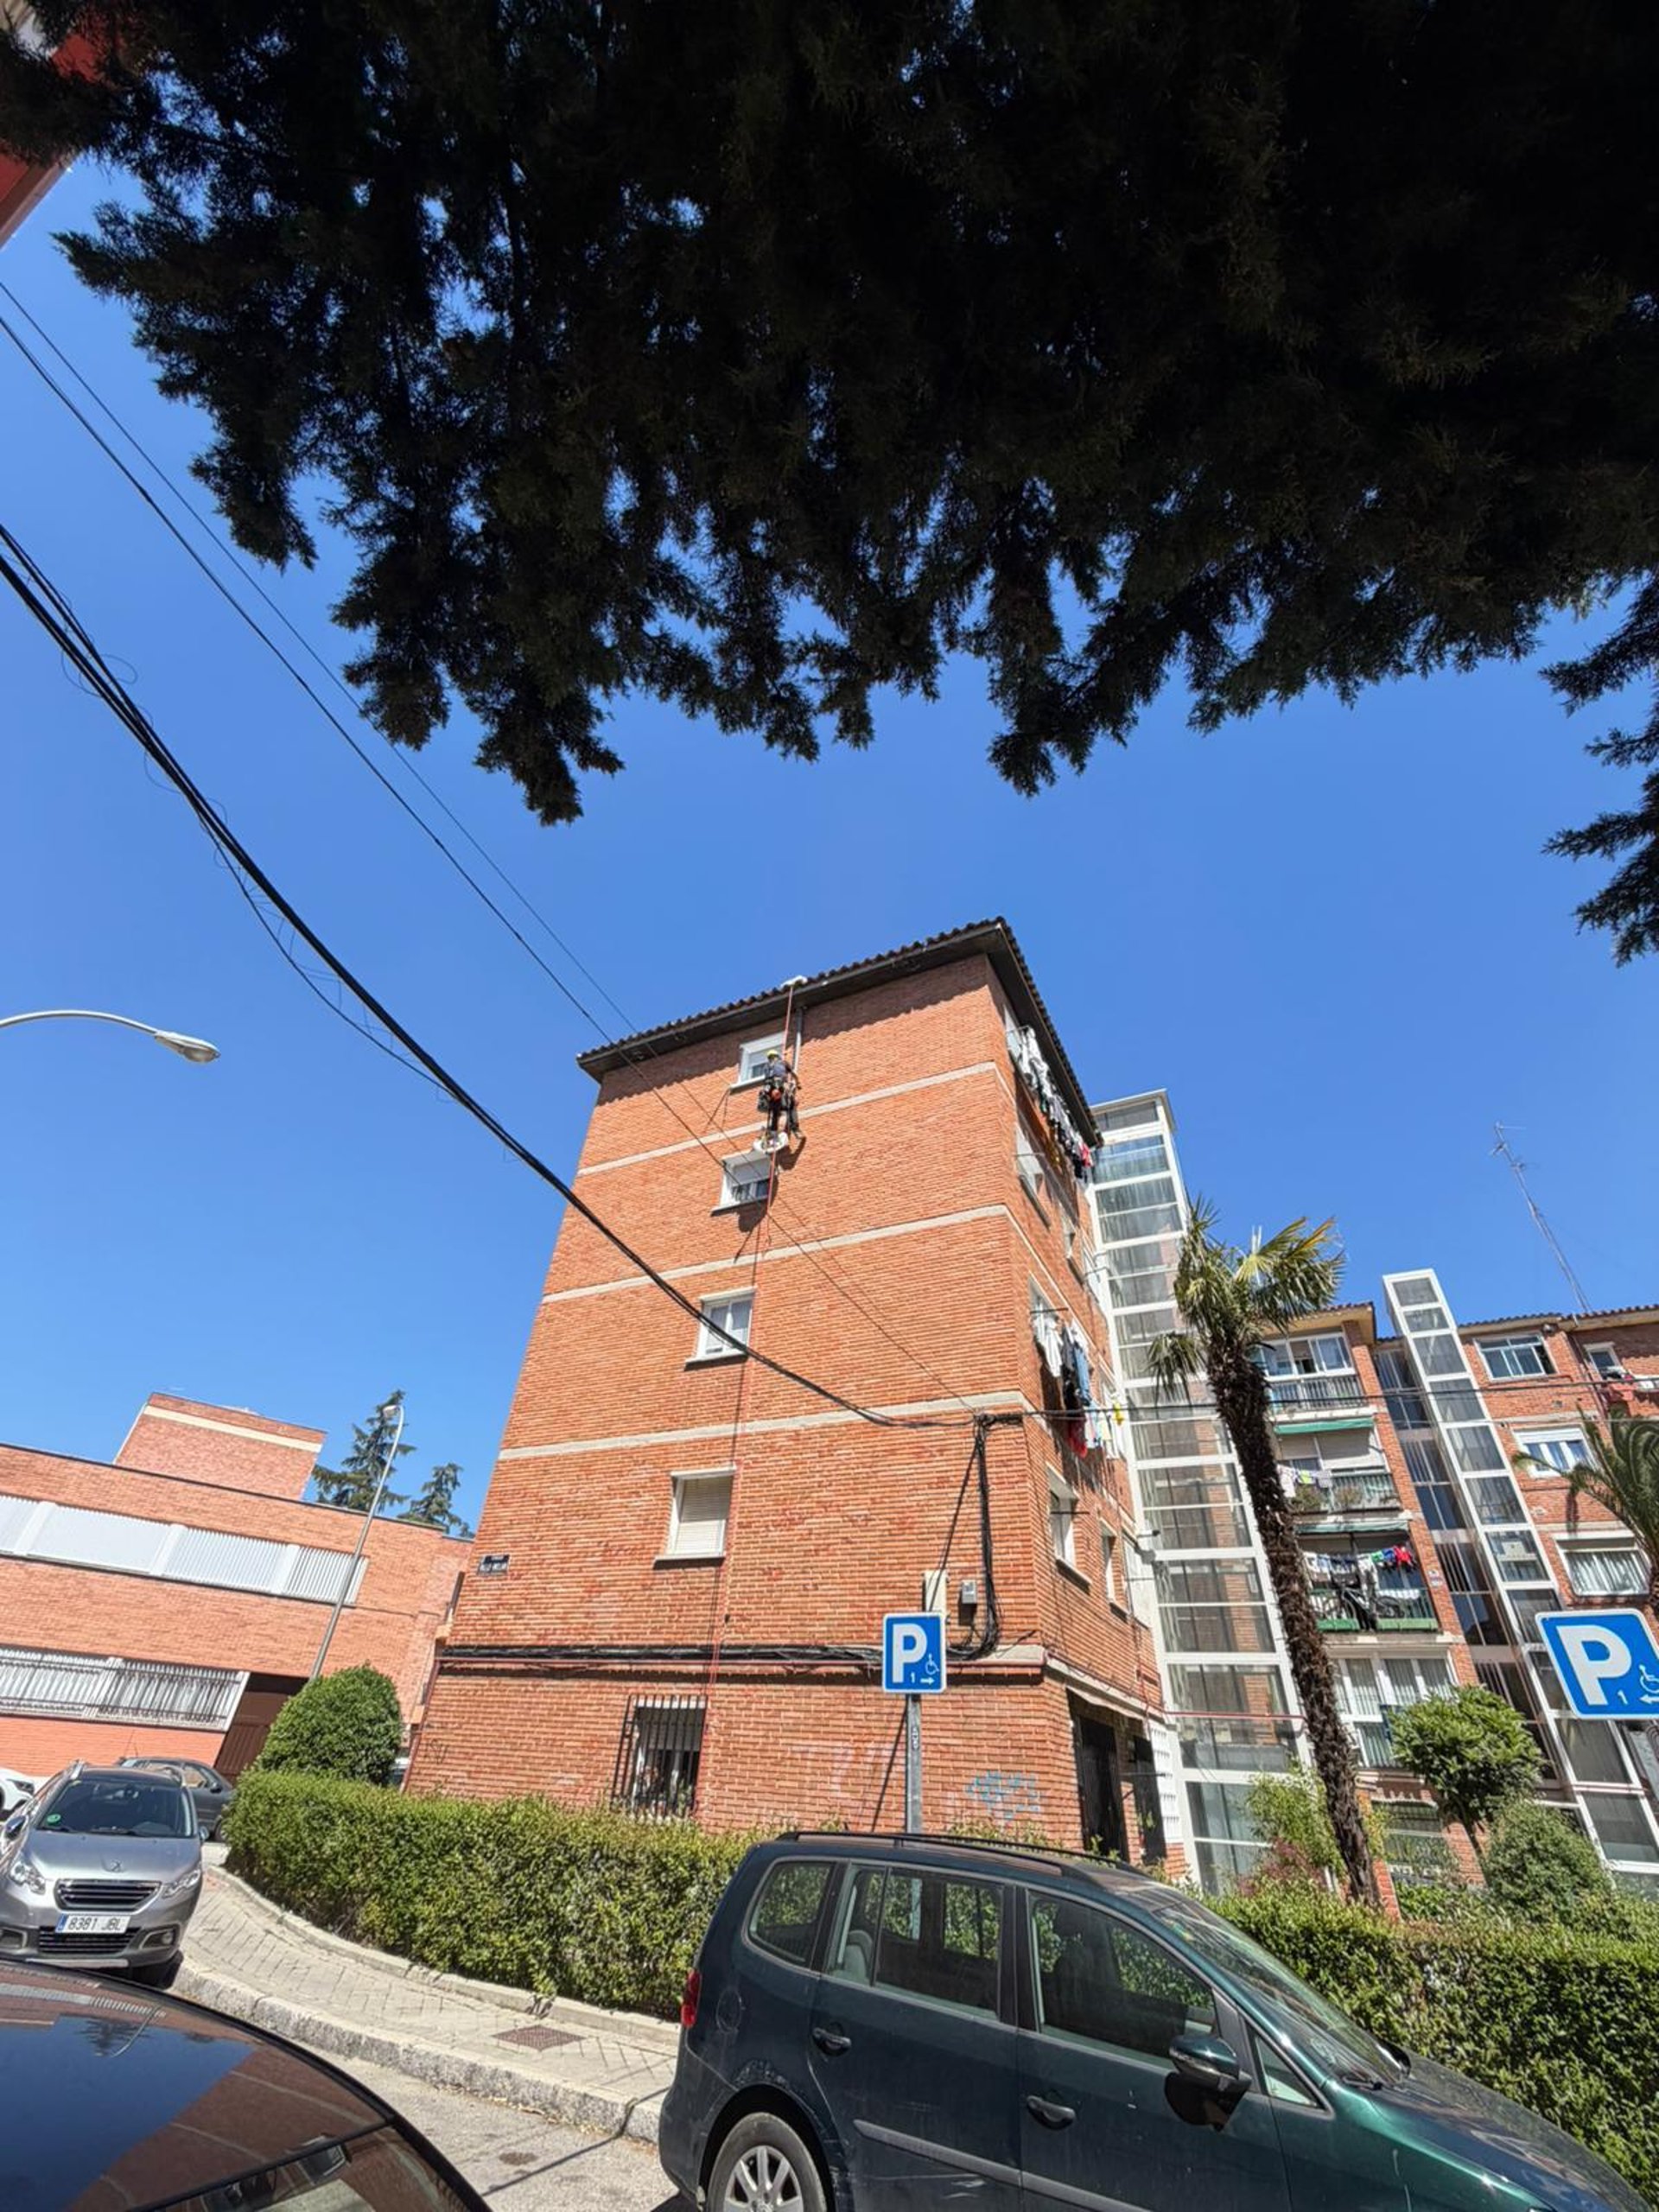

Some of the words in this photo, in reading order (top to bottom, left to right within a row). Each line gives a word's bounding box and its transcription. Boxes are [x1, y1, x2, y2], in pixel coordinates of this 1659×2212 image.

[892, 1623, 928, 1684] P
[1555, 1624, 1632, 1706] P
[910, 1672, 916, 1684] 1
[1618, 1689, 1628, 1705] 1
[67, 1916, 98, 1931] 8381
